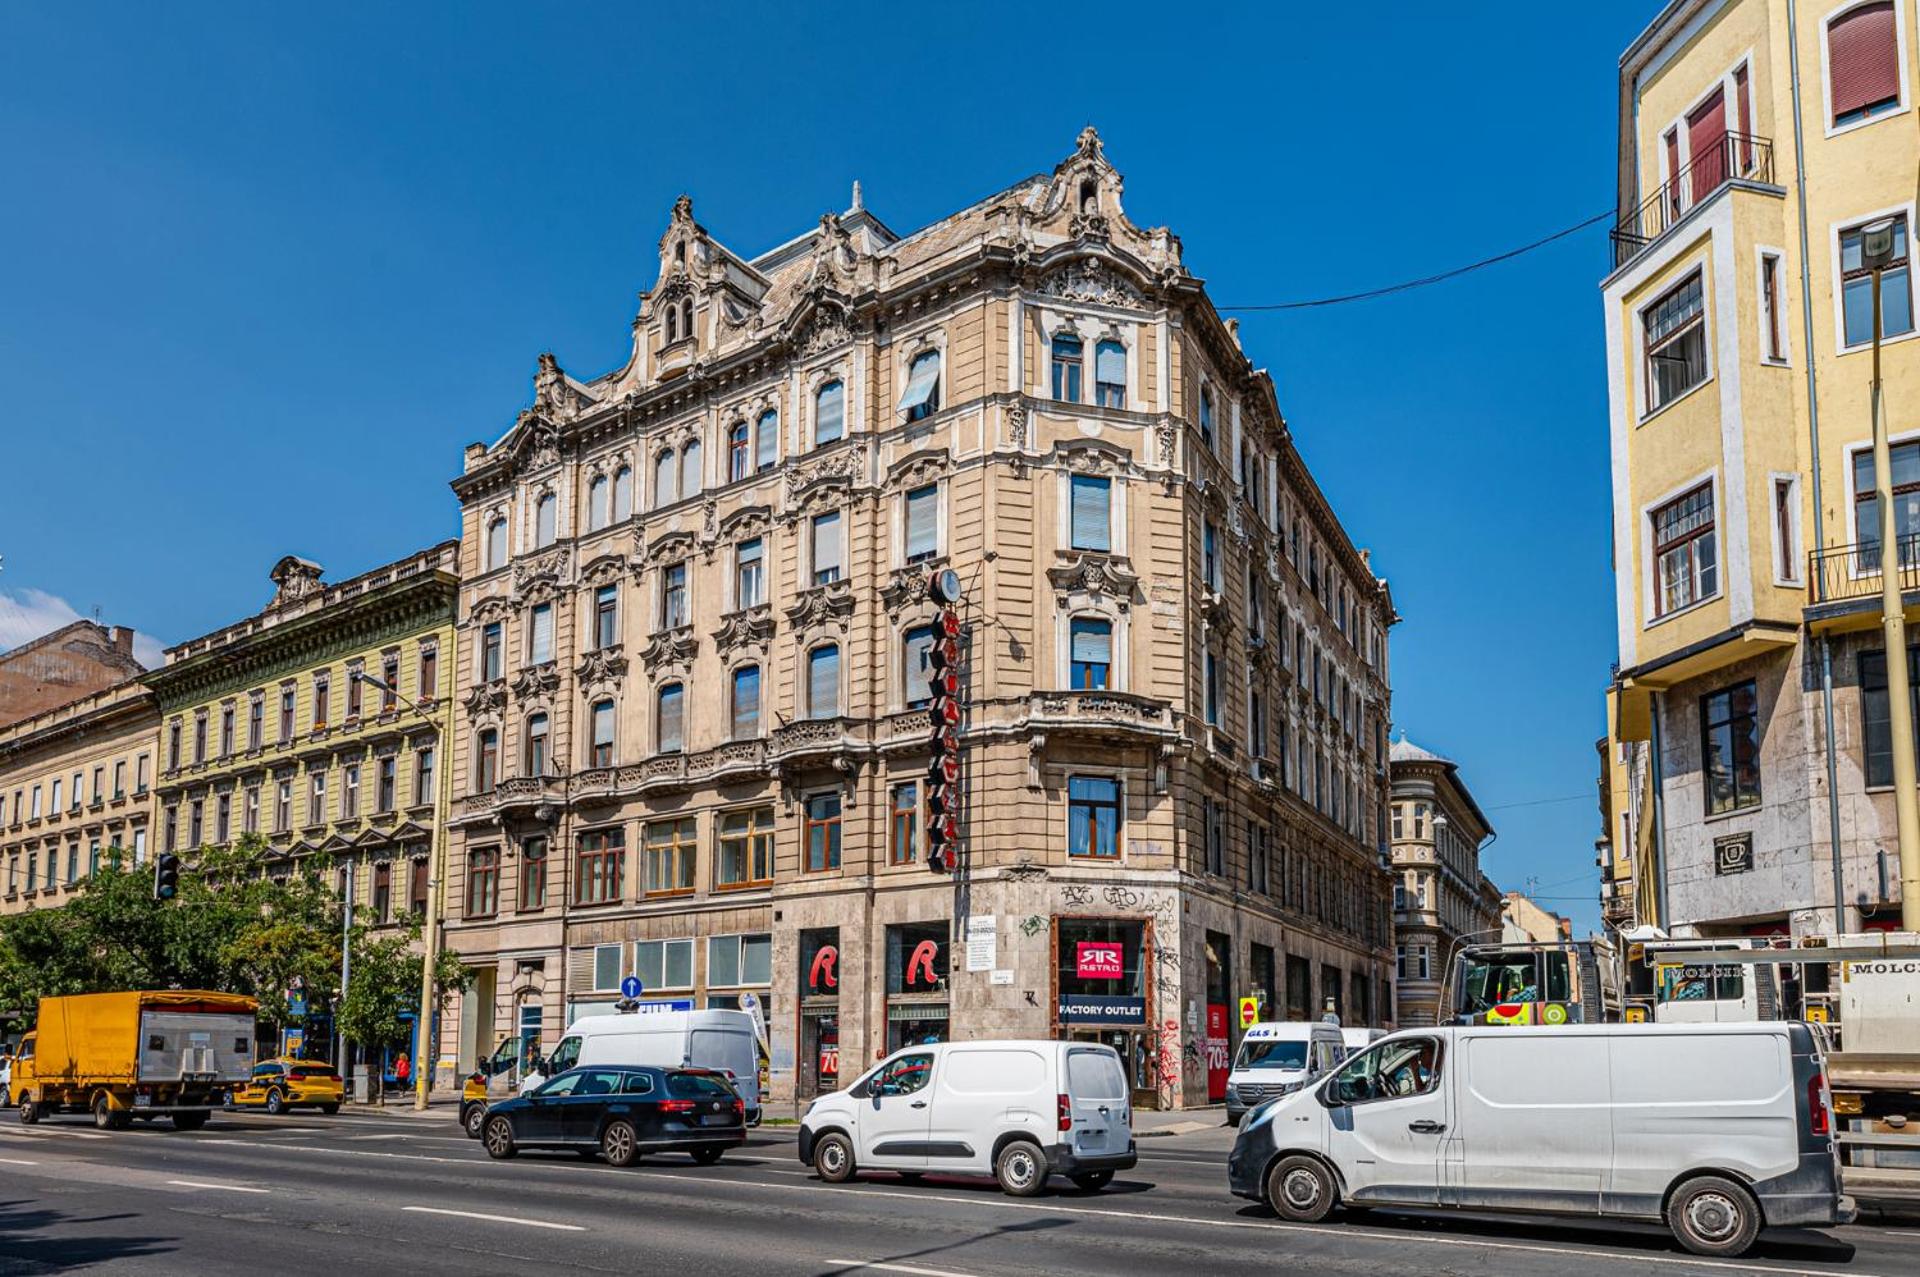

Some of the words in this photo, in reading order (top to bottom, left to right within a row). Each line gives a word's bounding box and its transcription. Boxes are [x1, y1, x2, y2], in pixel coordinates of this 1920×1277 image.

[1080, 964, 1120, 972] RETRO
[1853, 963, 1920, 974] MOLC
[1059, 1005, 1103, 1014] FACTORY
[1105, 1006, 1142, 1016] OUTLET
